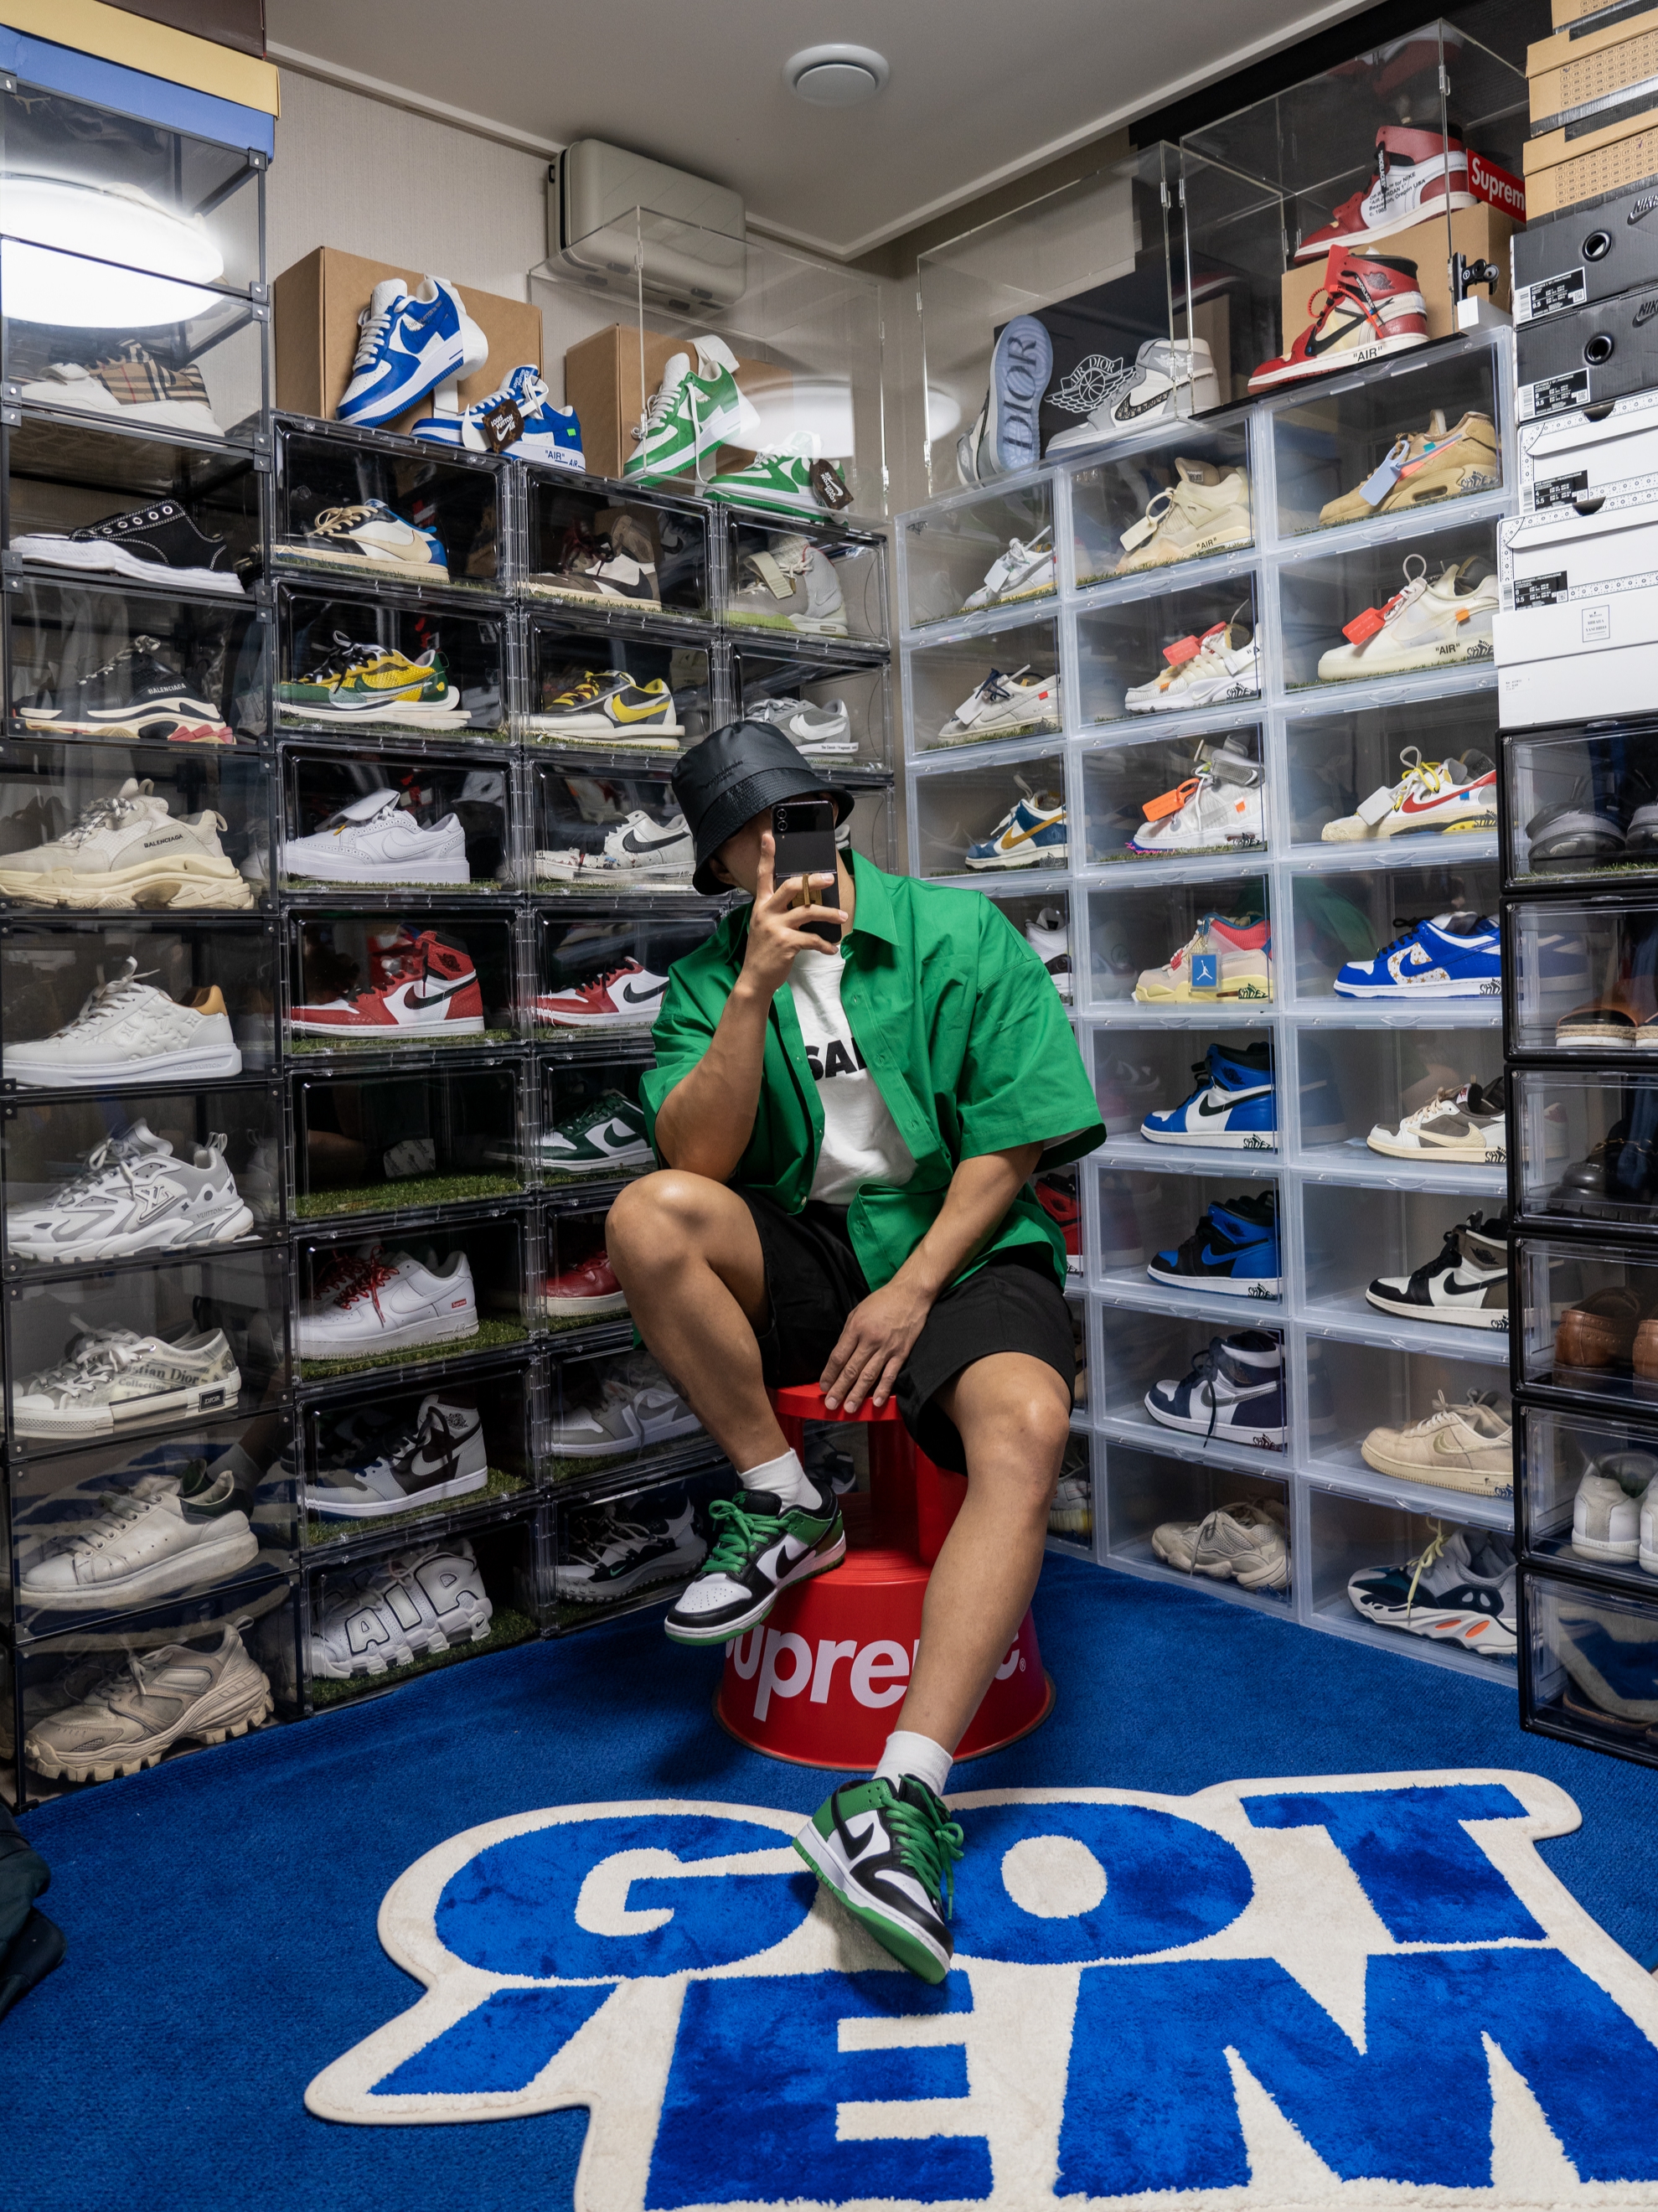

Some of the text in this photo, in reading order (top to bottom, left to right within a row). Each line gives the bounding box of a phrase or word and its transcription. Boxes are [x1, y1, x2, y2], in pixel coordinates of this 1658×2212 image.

[1402, 172, 1416, 183] NIKE
[1413, 179, 1426, 189] USA
[1471, 158, 1526, 211] Suprem
[1381, 187, 1401, 201] JRDAN
[1638, 299, 1658, 317] NIK
[1353, 345, 1382, 362] "AIR"
[1070, 356, 1115, 387] AIR DIOR
[1002, 337, 1037, 451] DIOR
[491, 414, 504, 427] LOUIS
[496, 414, 514, 430] VUITTON
[545, 450, 565, 461] "AIR"
[569, 459, 578, 468] AIR
[1196, 536, 1217, 549] "AIR"
[1435, 643, 1460, 655] "AIR"
[148, 683, 187, 695] BALENCIAGA
[143, 834, 183, 848] BALENCIAGA
[196, 1207, 223, 1219] VUITTON
[169, 1367, 199, 1384] Dior
[118, 1377, 167, 1392] Collection
[204, 1395, 221, 1405] DIOR
[726, 1623, 1020, 1723] upre
[433, 1782, 1550, 1980] GOT
